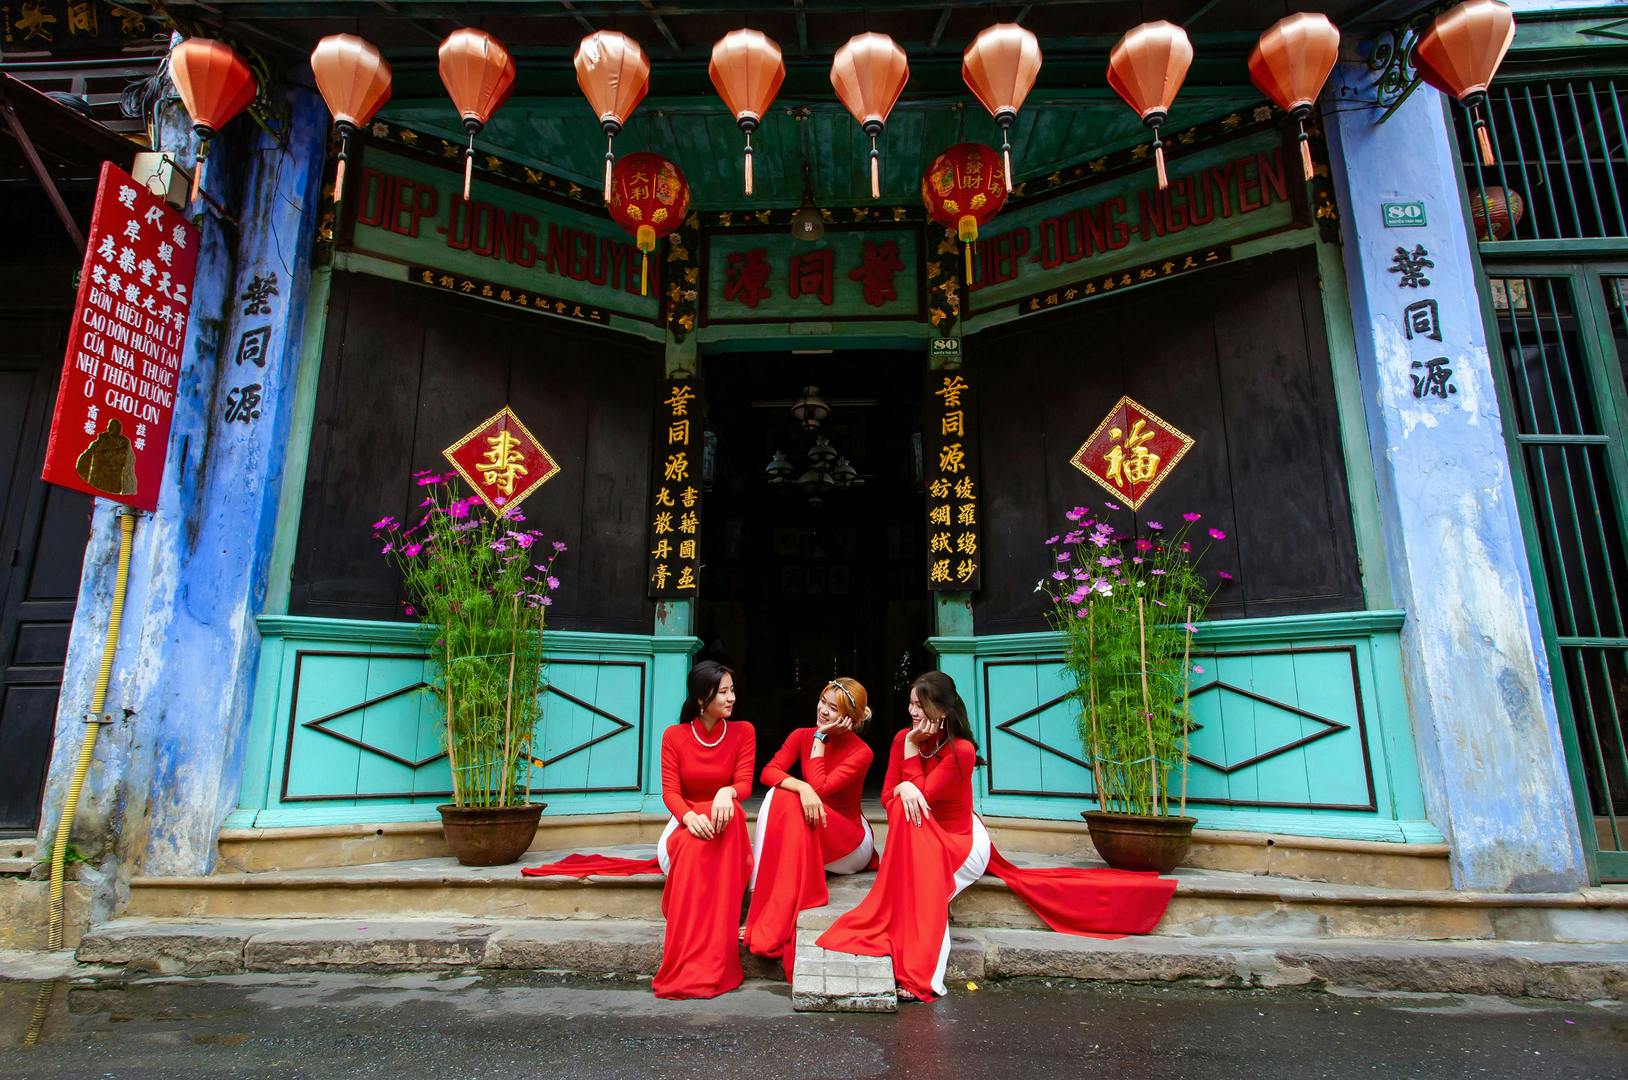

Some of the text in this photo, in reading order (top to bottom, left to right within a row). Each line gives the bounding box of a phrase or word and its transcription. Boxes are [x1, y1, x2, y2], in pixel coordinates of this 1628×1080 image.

[1388, 205, 1421, 219] 80
[83, 307, 106, 332] CAO
[224, 271, 279, 425] 葉同源
[934, 339, 958, 350] 80
[1387, 243, 1457, 399] 葉同源
[663, 385, 696, 483] 葉同源
[935, 375, 969, 474] 葉同源
[1103, 418, 1160, 488] 福
[475, 429, 529, 496] 壽
